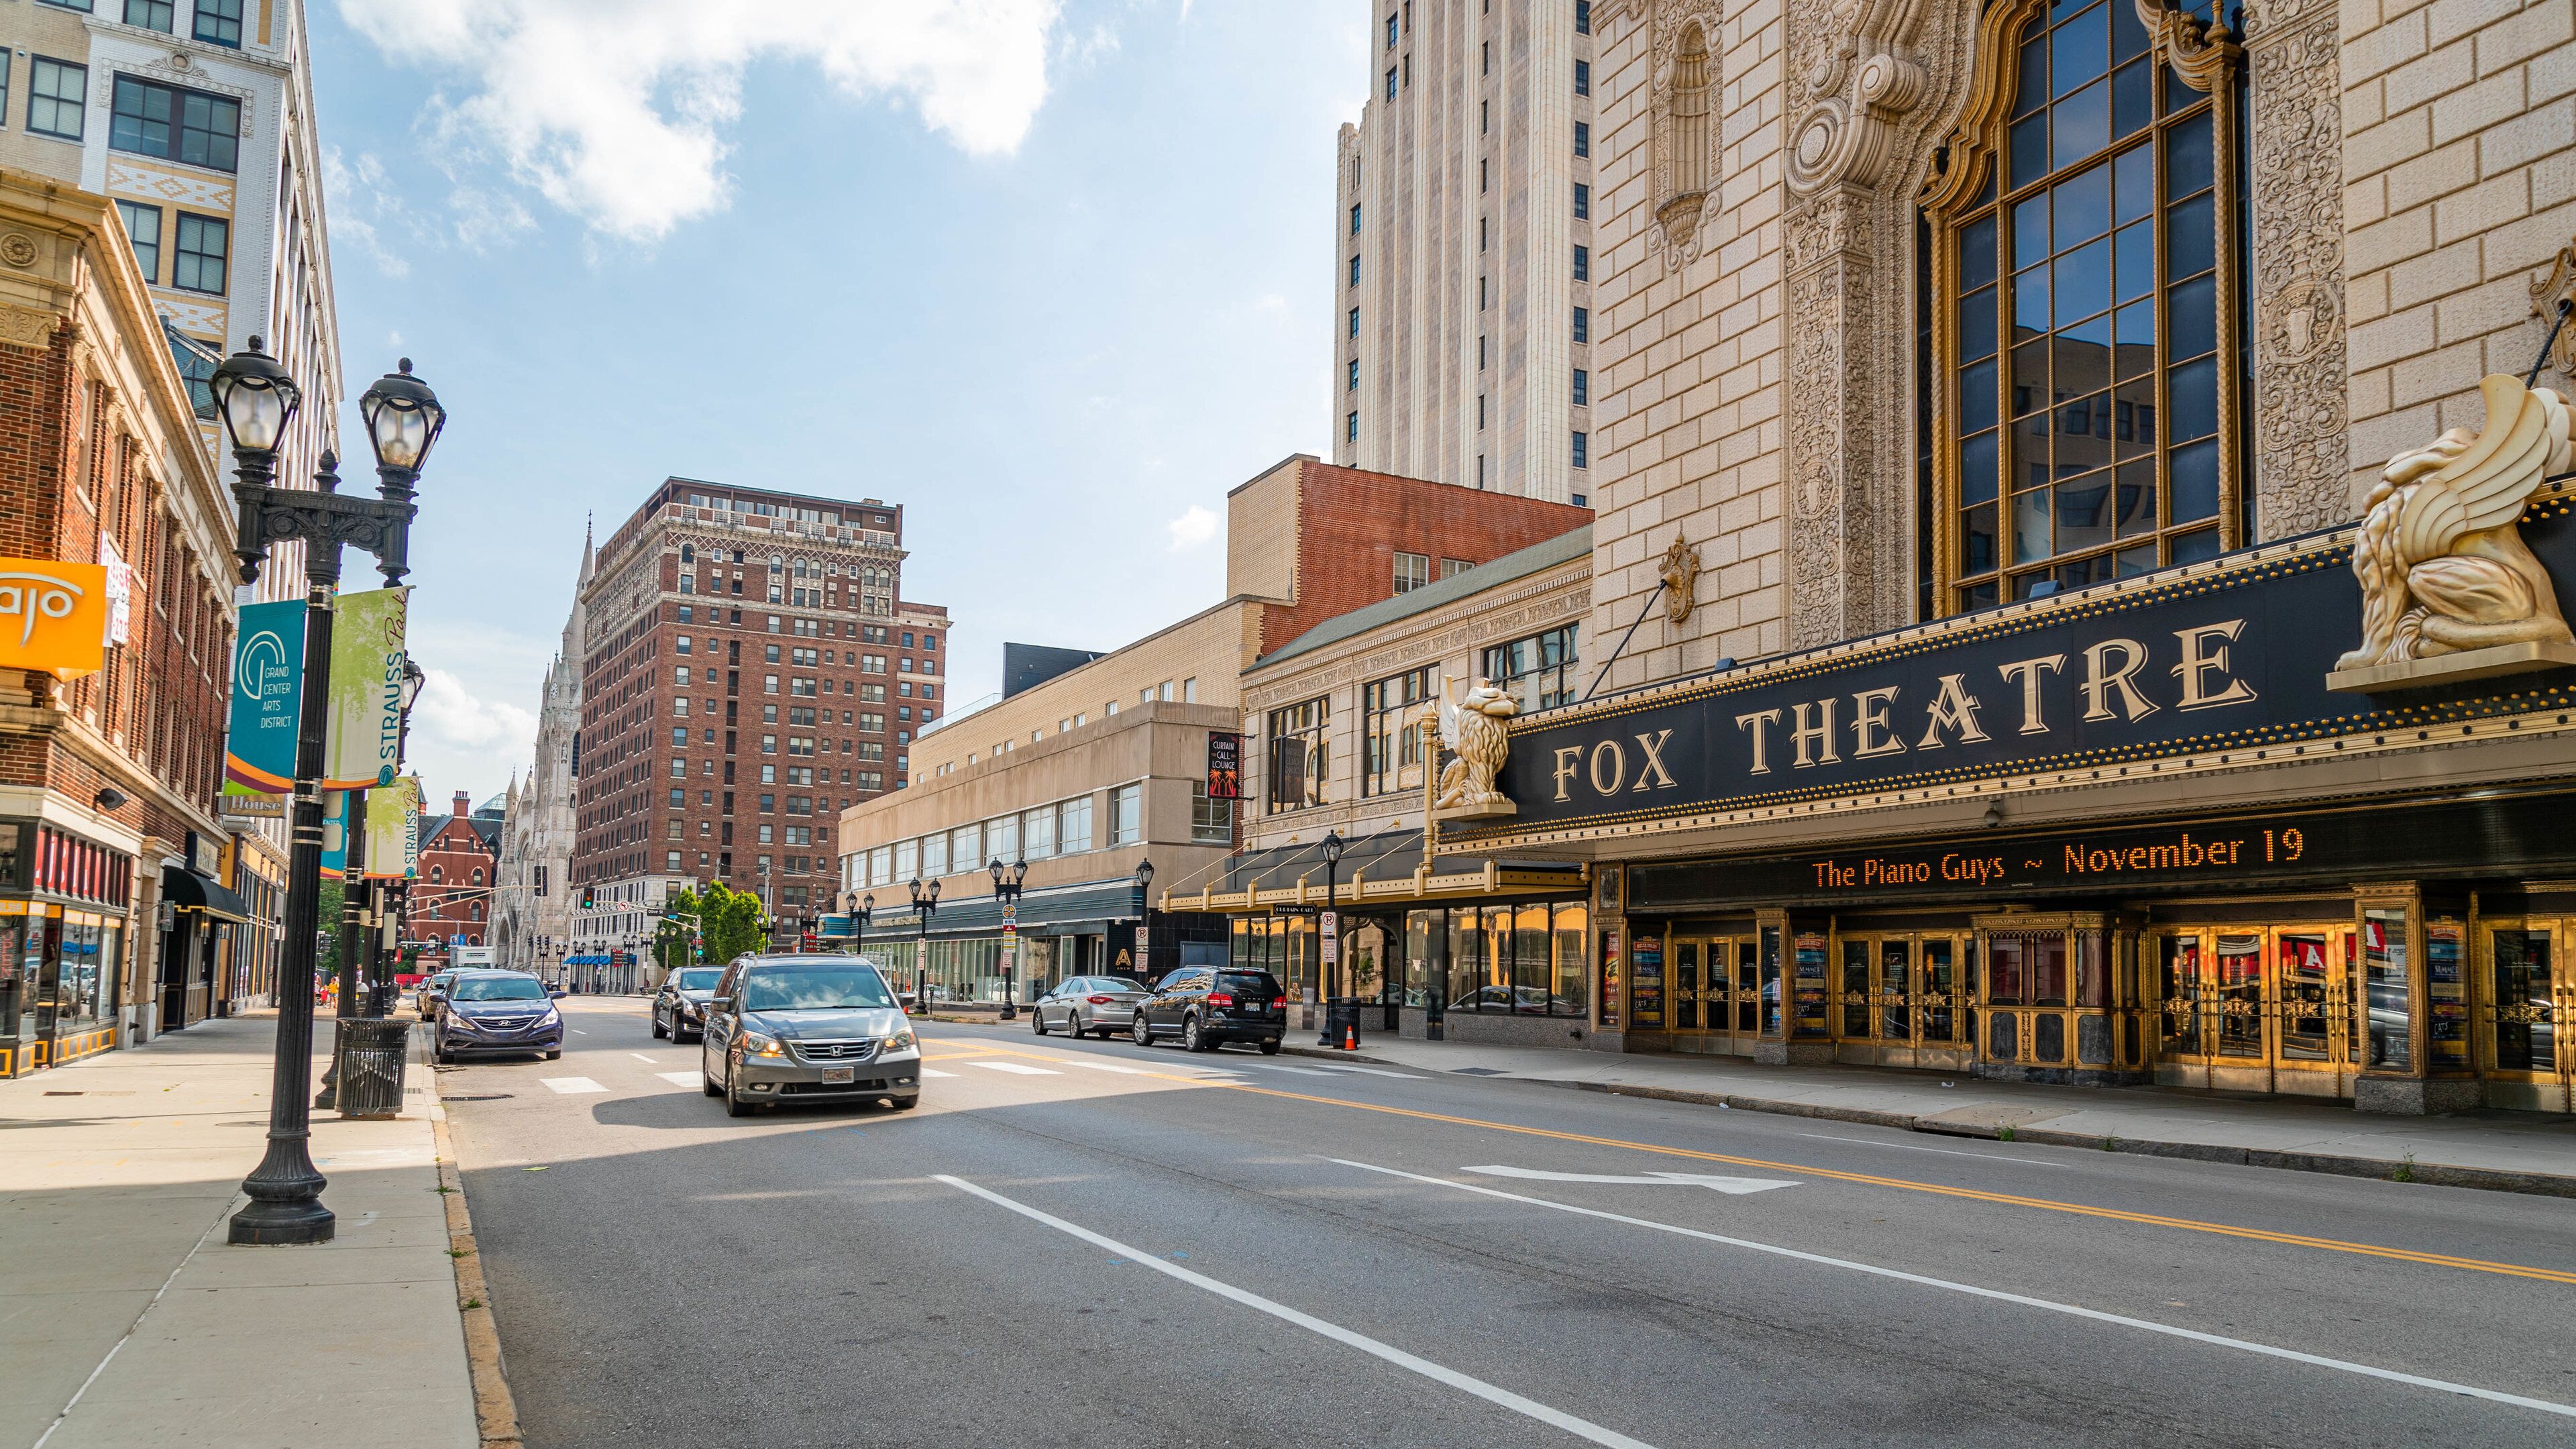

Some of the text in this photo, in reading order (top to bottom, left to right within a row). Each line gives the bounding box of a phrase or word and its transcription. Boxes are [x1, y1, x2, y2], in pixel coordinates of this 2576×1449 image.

[384, 591, 407, 646] Park
[265, 666, 289, 678] GRAND
[264, 683, 291, 695] CENTER
[262, 700, 281, 711] ARTS
[380, 651, 403, 759] STRAUSS
[1552, 619, 2258, 803] FOX THEATRE
[260, 716, 292, 729] DISTRICT
[1213, 741, 1234, 750] CURTAIN
[1216, 751, 1230, 759] CALL
[1212, 760, 1235, 769] LOUNGE
[403, 778, 419, 807] Park
[231, 796, 281, 811] House
[405, 809, 417, 864] STRAUSS
[1813, 861, 1855, 887] The
[1865, 859, 1930, 885] Piano
[1942, 853, 2004, 885] Guys
[2065, 833, 2245, 873] November
[2263, 828, 2303, 862] 19
[0, 929, 14, 977] OPEN
[2434, 965, 2459, 973] SUMMER
[1635, 1000, 1646, 1009] CATS
[1797, 1005, 1810, 1014] CATS
[2434, 1022, 2448, 1034] CATS
